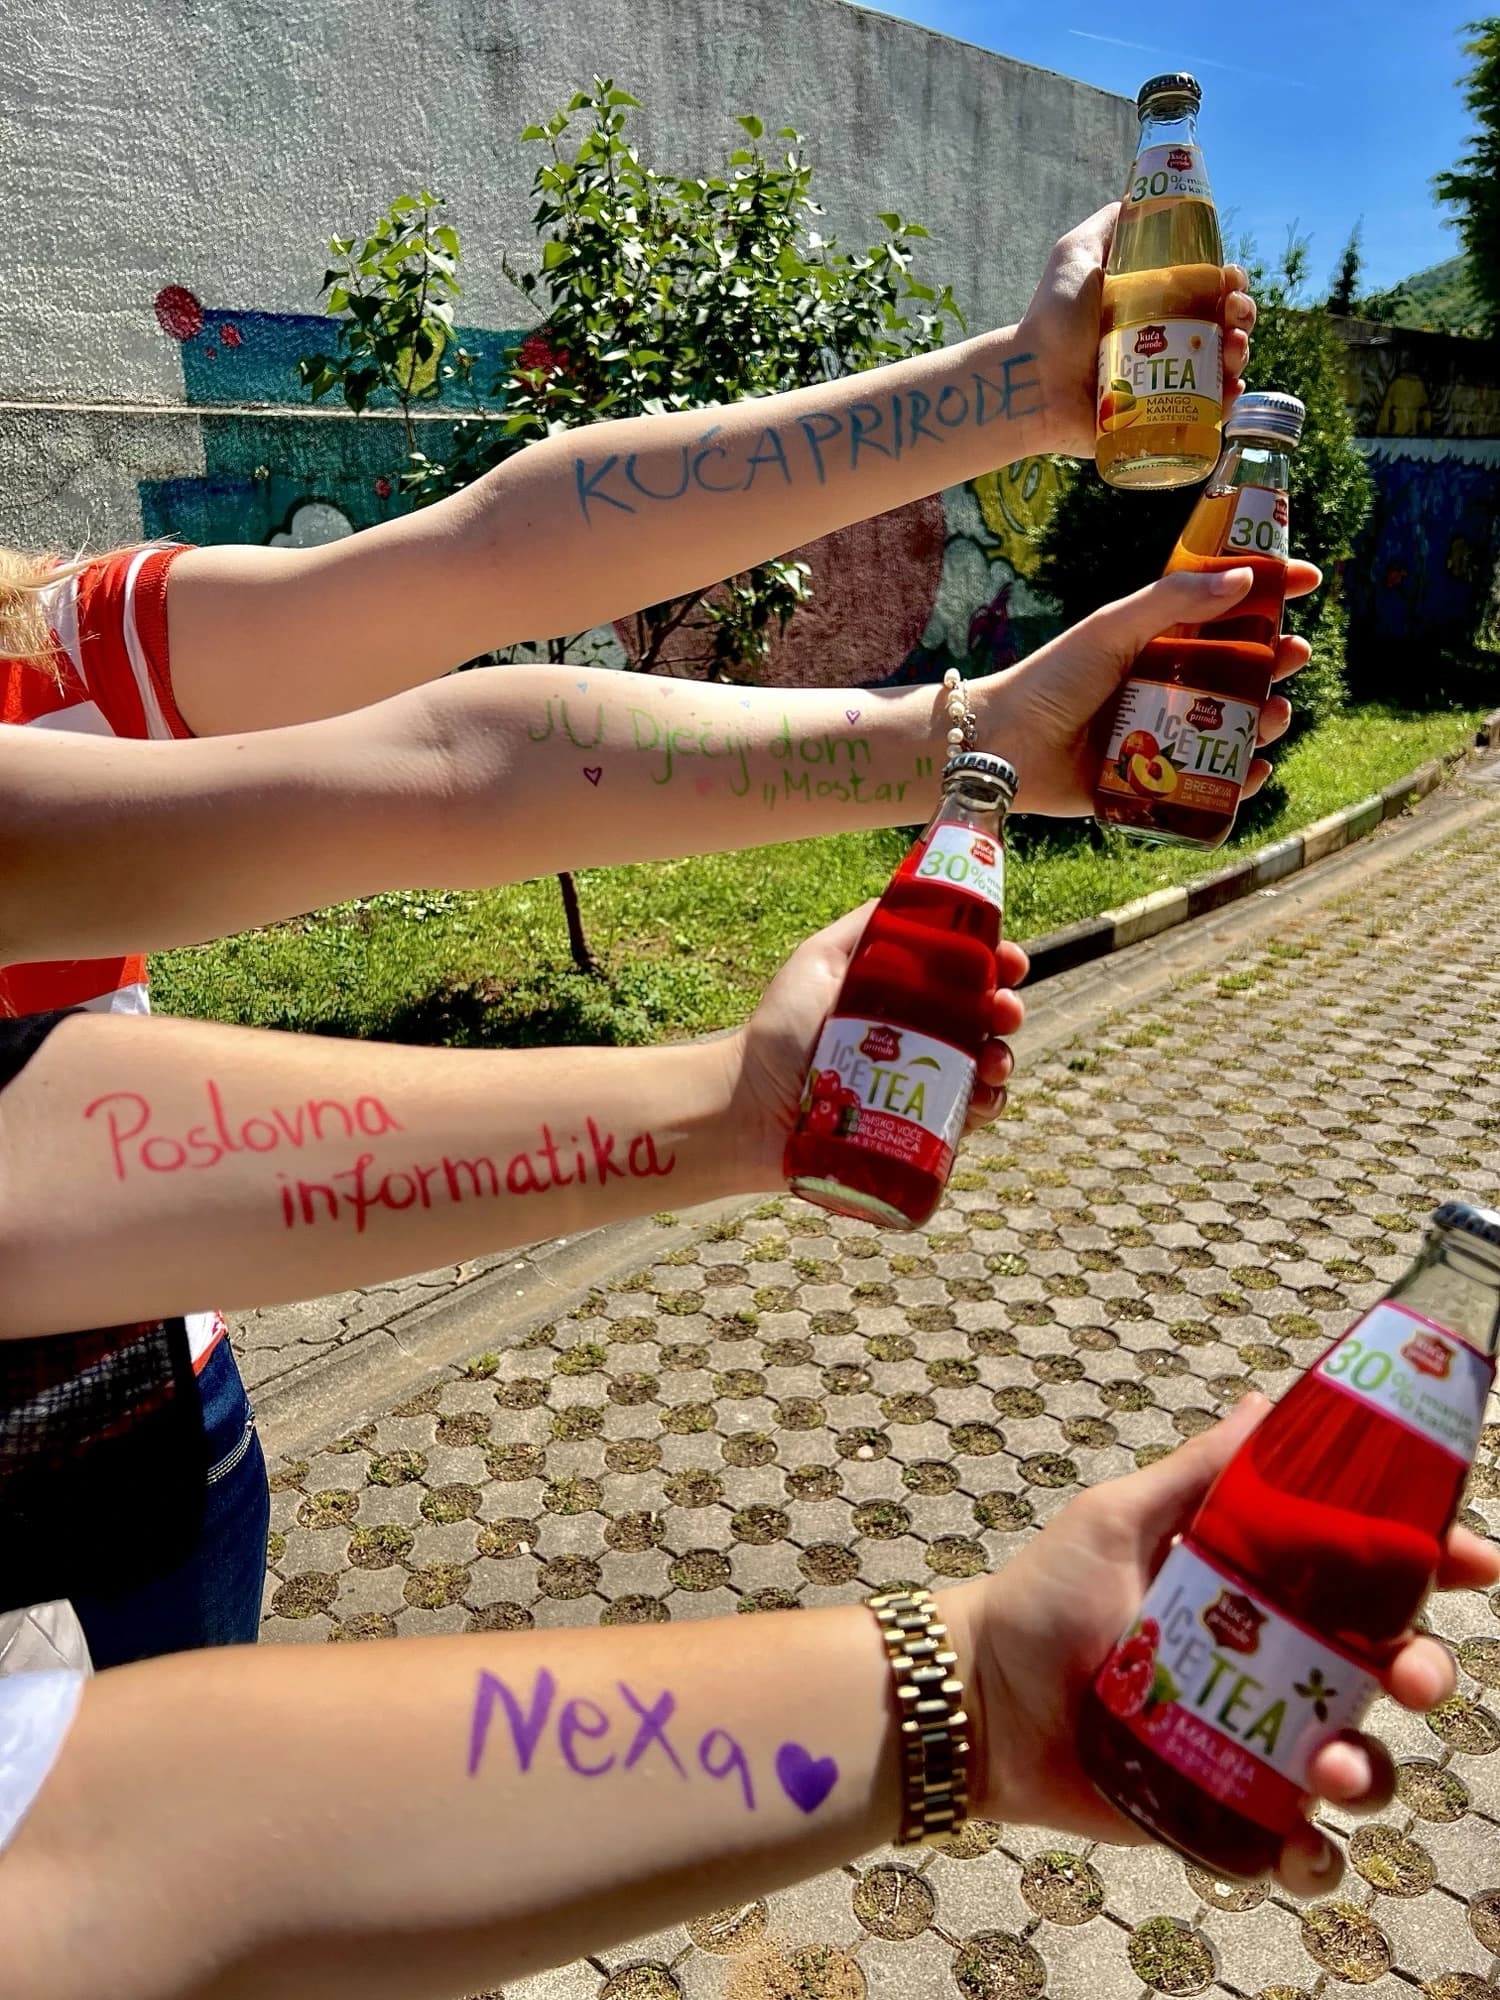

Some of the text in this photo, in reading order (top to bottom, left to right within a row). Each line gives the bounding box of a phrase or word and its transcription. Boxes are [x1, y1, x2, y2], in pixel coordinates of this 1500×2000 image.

[1139, 330, 1160, 342] kuća
[1147, 397, 1191, 406] MANGO
[1146, 406, 1199, 415] KAMILICA
[1195, 702, 1217, 716] kuća
[768, 713, 872, 766] dom
[84, 1079, 405, 1180] Poslovna
[278, 1116, 676, 1232] informatika
